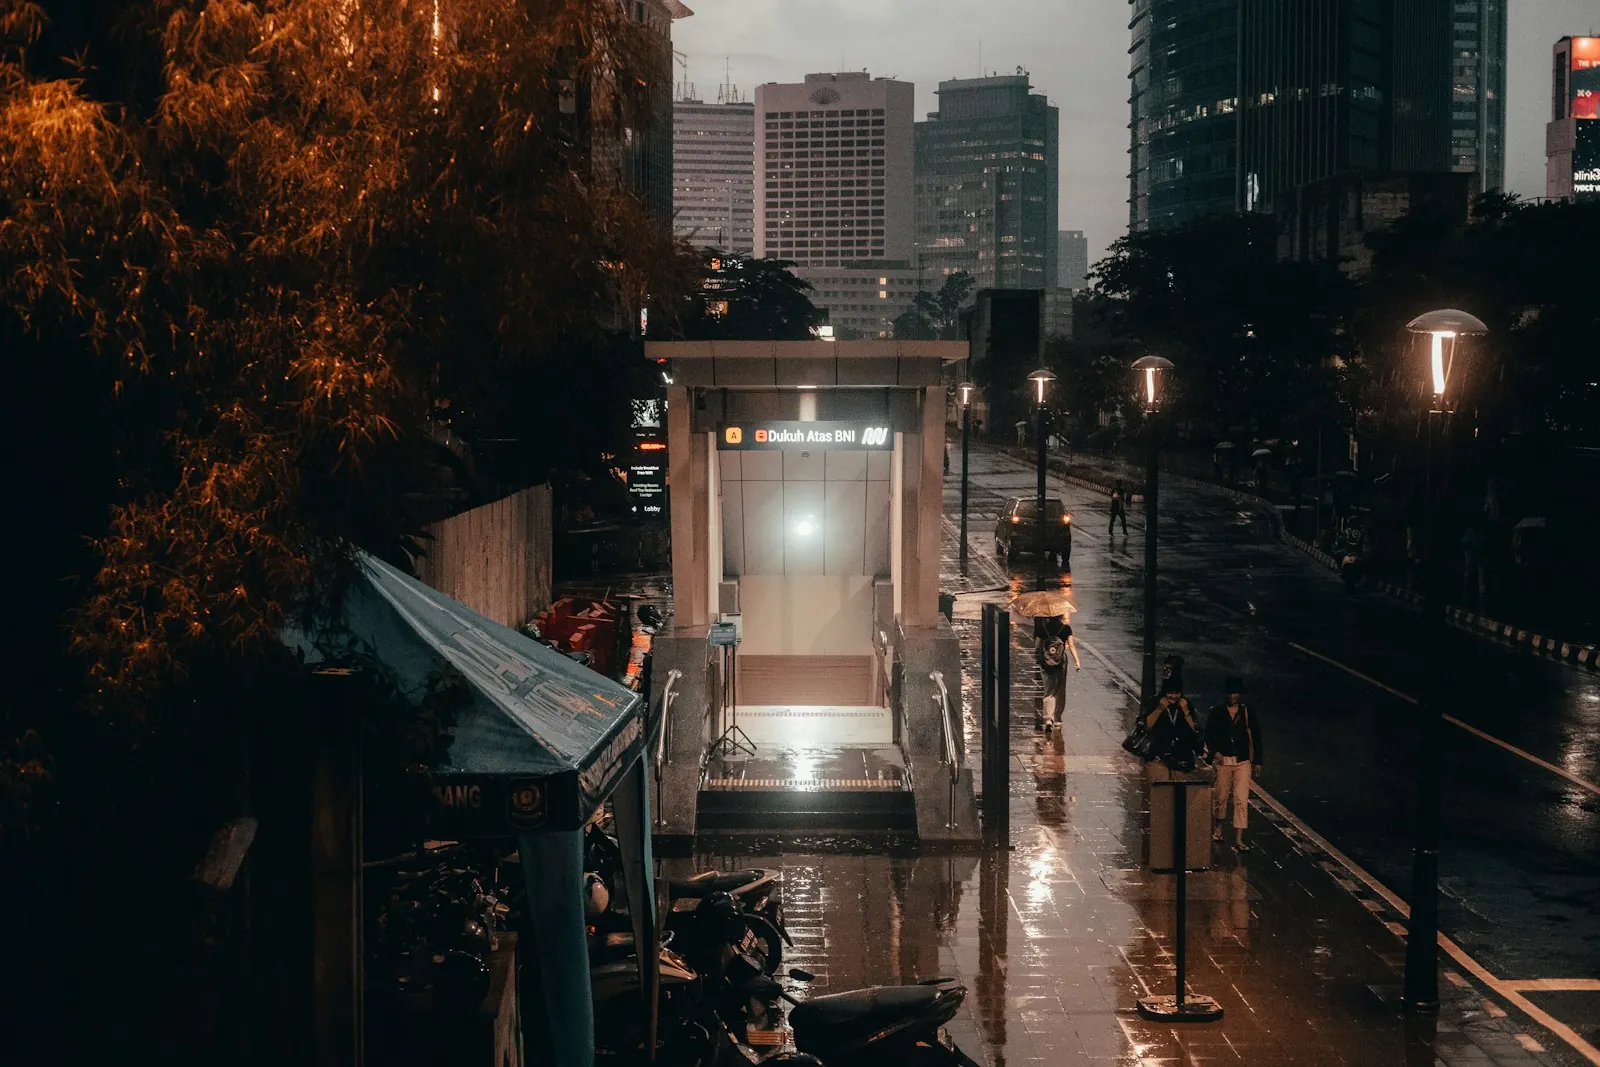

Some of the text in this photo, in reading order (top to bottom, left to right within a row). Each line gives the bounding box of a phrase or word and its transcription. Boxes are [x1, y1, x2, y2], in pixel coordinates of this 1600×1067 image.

[768, 429, 804, 443] Dukuh
[806, 430, 832, 443] Atas
[835, 430, 855, 443] BNI
